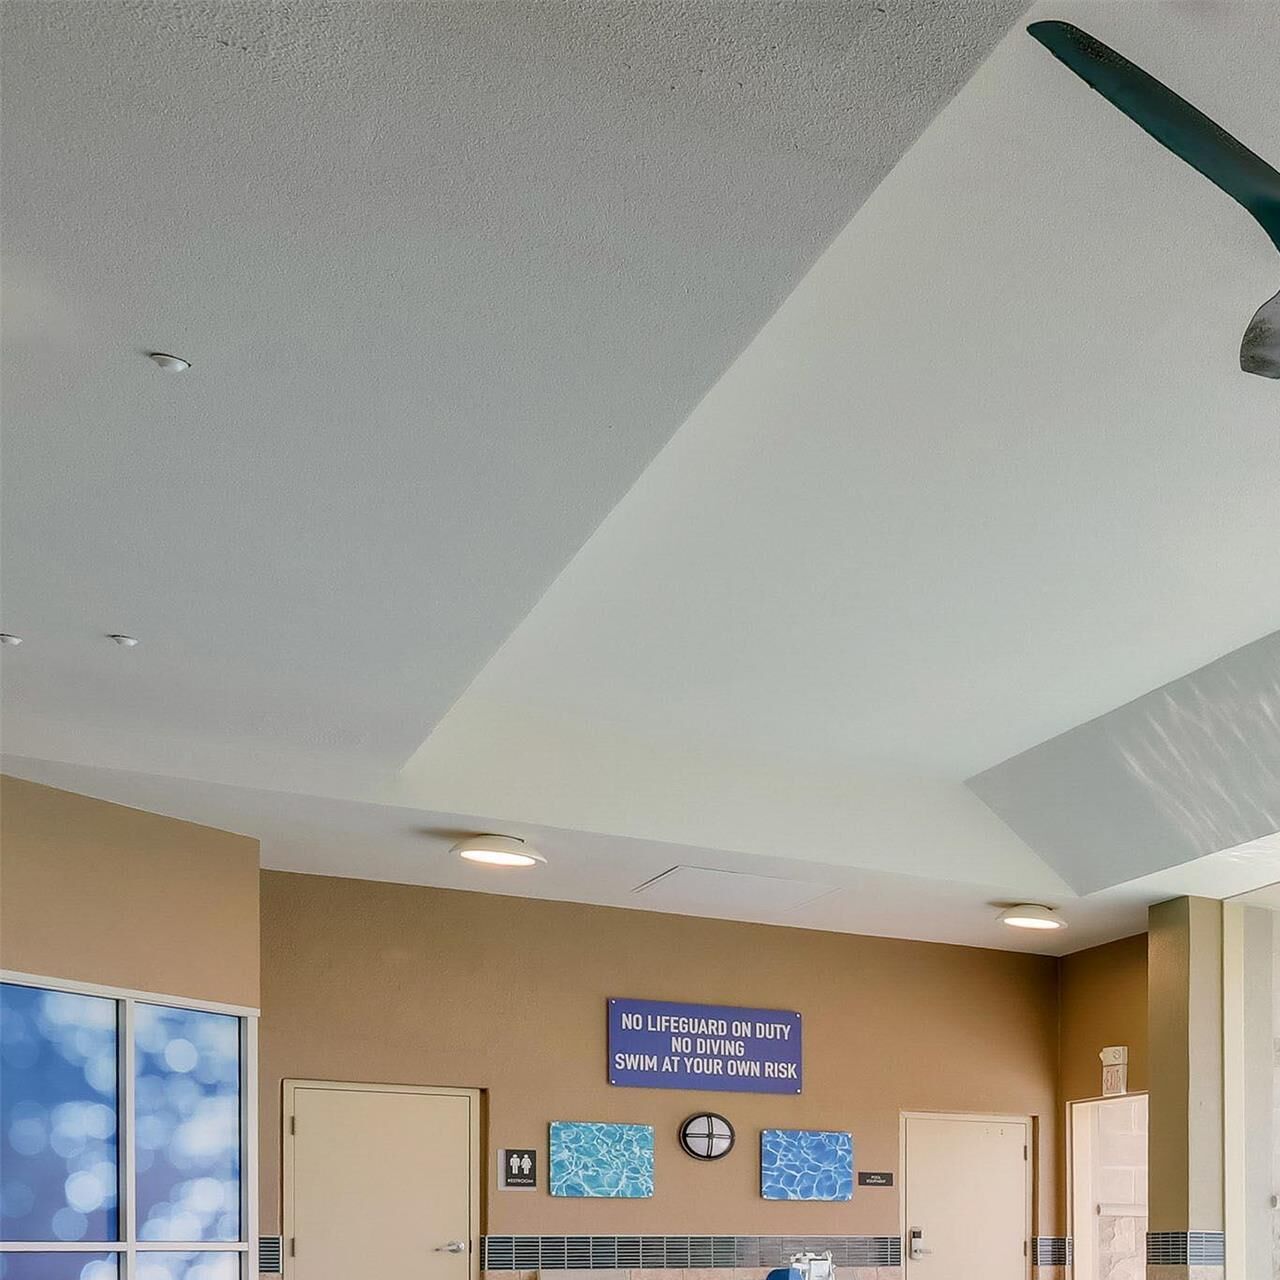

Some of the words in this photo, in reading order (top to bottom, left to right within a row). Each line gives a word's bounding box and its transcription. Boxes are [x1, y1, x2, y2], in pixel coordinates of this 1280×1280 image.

[622, 1013, 642, 1030] NO
[648, 1014, 727, 1036] LIFEGUARD
[732, 1021, 751, 1037] ON
[756, 1023, 791, 1040] DUTY
[672, 1037, 691, 1053] NO
[696, 1038, 745, 1056] DIVING
[615, 1053, 658, 1072] SWIM
[662, 1056, 680, 1072] AT
[684, 1057, 723, 1075] YOUR
[728, 1060, 760, 1077] OWN
[765, 1062, 798, 1079] RISK
